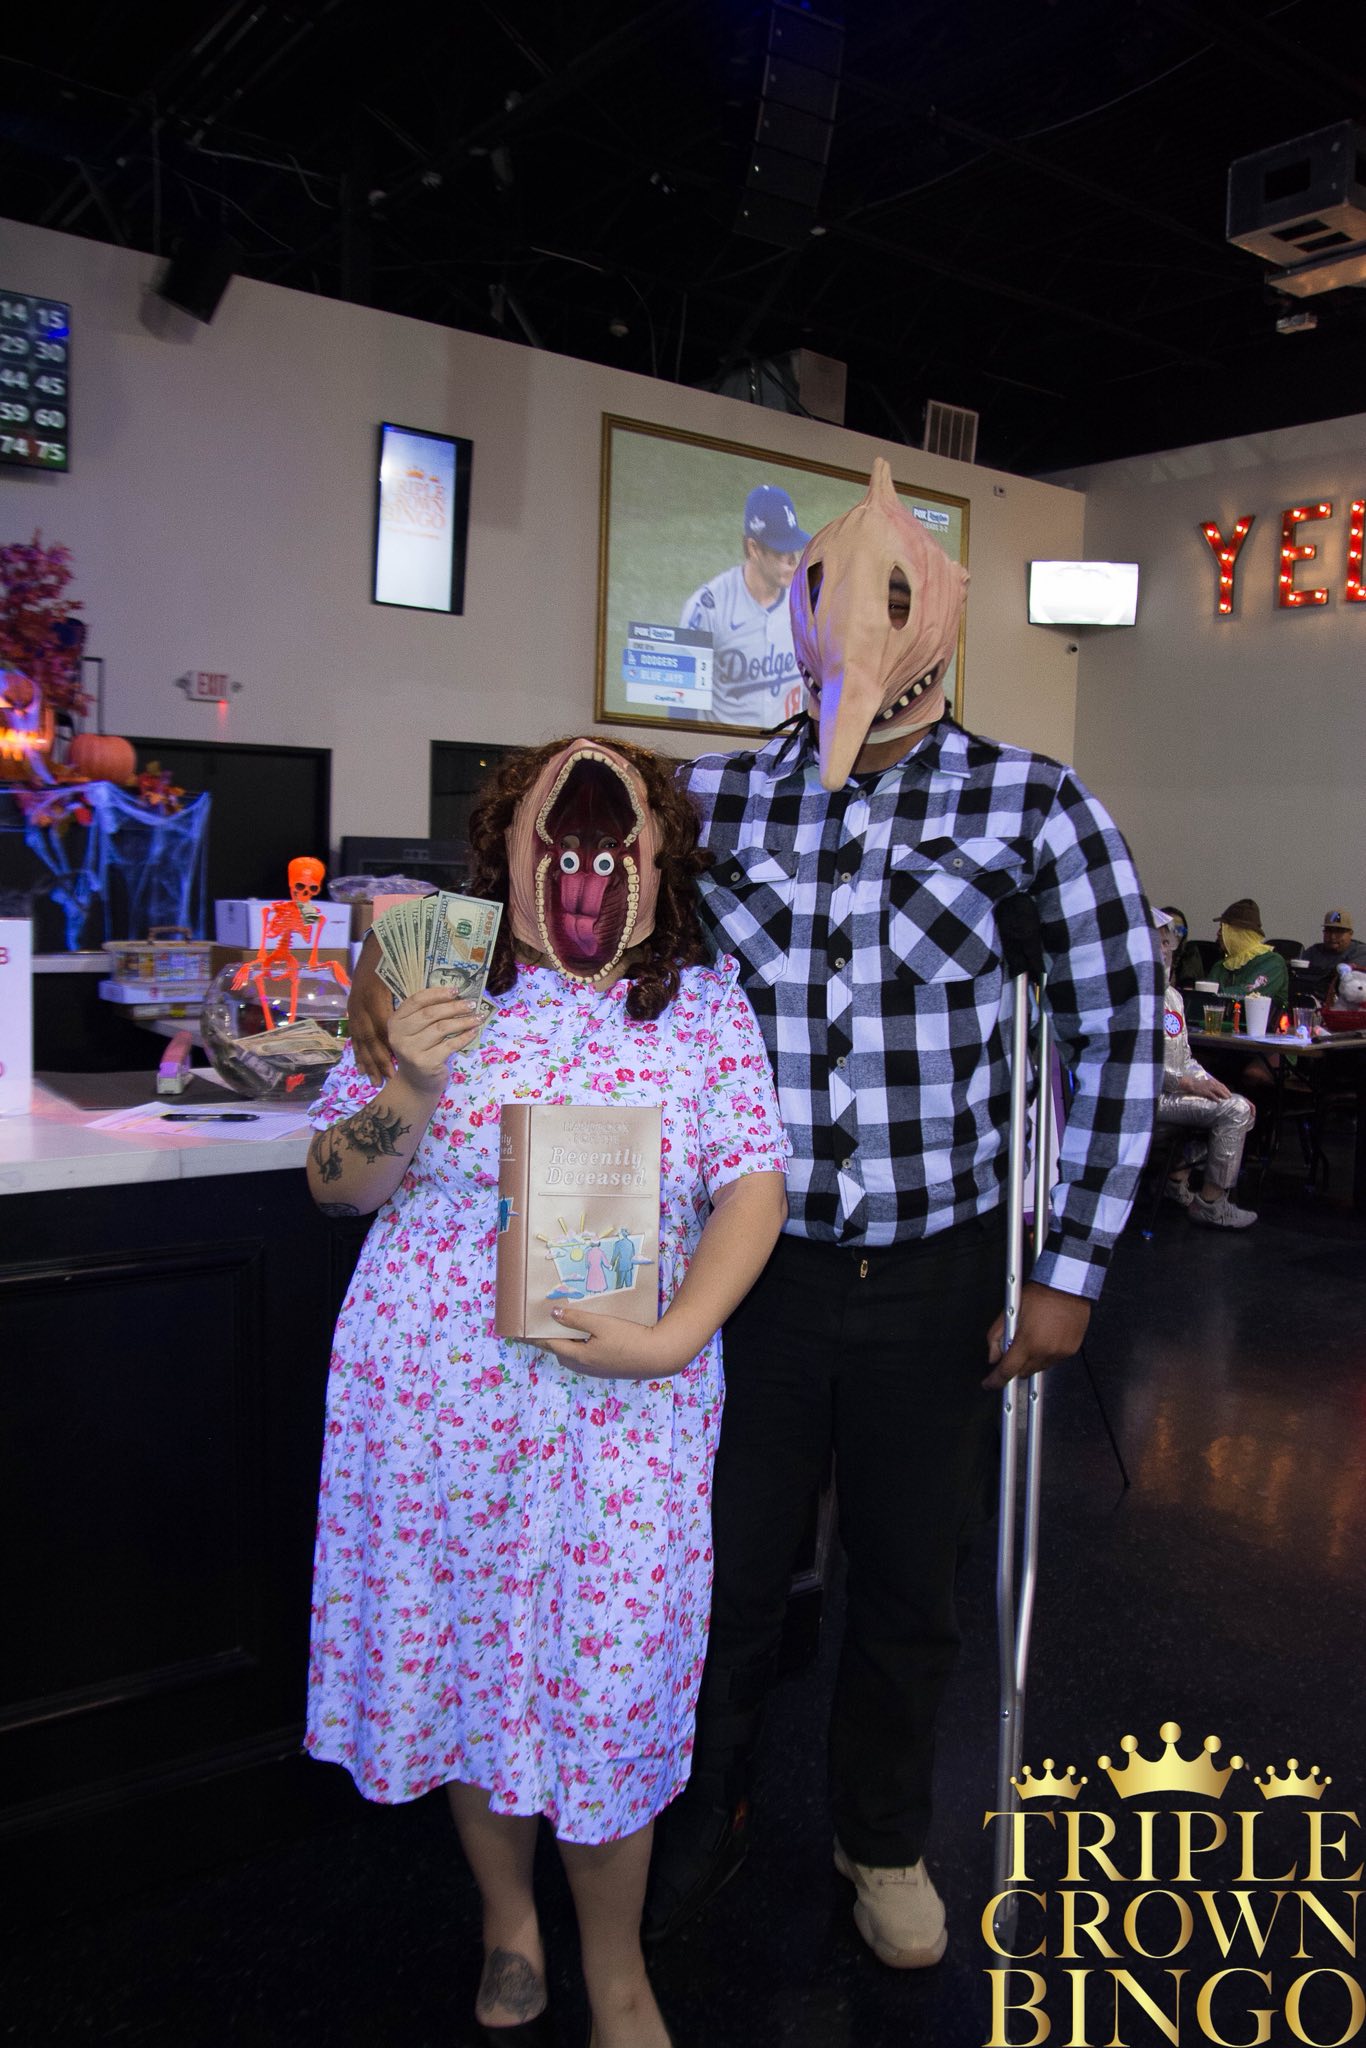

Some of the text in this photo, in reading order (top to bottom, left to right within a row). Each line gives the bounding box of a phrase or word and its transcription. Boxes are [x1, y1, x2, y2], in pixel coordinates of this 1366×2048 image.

[0, 302, 66, 330] 14 15
[0, 334, 66, 363] 29 30
[0, 368, 66, 396] 44 45
[0, 402, 66, 430] 59 60
[0, 435, 66, 462] 74 75
[640, 654, 679, 668] DODGERS
[719, 644, 797, 697] Dodge
[197, 672, 228, 697] EXIT
[551, 1146, 644, 1168] Recently
[546, 1167, 648, 1187] Deceased
